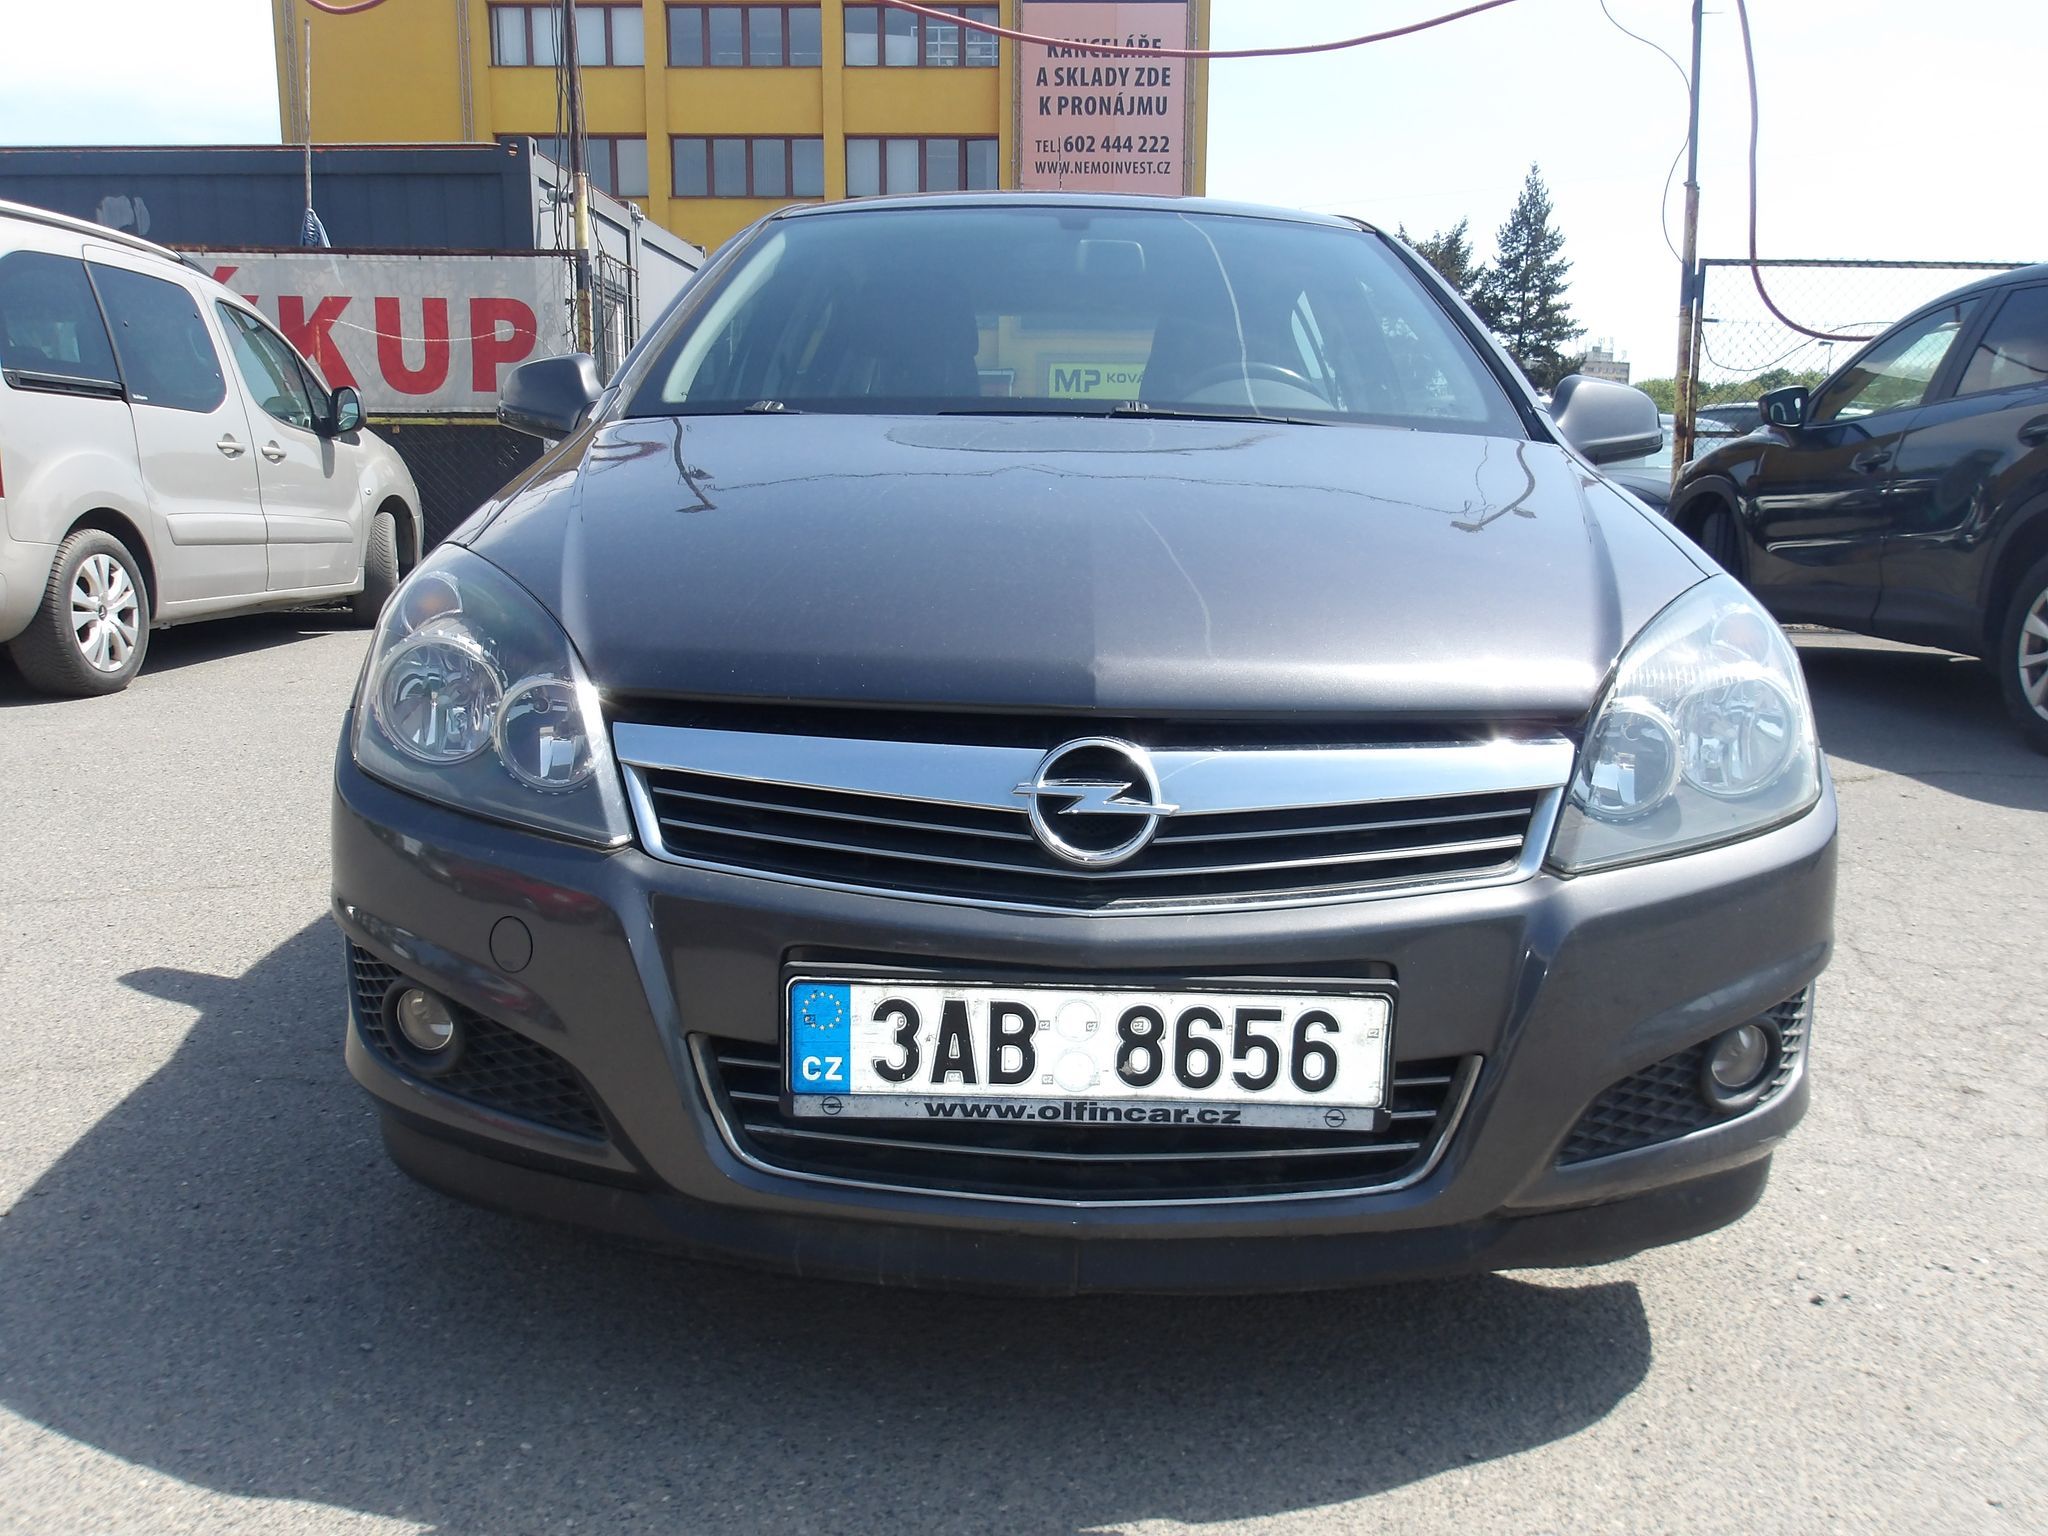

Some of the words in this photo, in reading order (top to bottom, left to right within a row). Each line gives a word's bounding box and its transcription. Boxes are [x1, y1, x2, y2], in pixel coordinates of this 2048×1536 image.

[1047, 34, 1162, 58] KANCELÁŘE
[1036, 67, 1048, 87] A
[1054, 67, 1130, 87] SKLADY
[1134, 67, 1171, 87] ZDE
[1039, 96, 1051, 116] K
[1058, 92, 1168, 116] PRONÁJMU
[1063, 136, 1096, 153] 602
[1101, 136, 1133, 153] 444
[1137, 136, 1170, 153] 222
[1035, 161, 1171, 175] WWW.NEMOINVEST.CZ
[213, 266, 538, 395] KUP
[1054, 368, 1101, 393] MP
[871, 998, 1038, 1085] 3AB
[1116, 1005, 1340, 1092] 8656
[801, 1056, 843, 1081] CZ
[924, 1101, 1241, 1125] www.olfincar.cz
